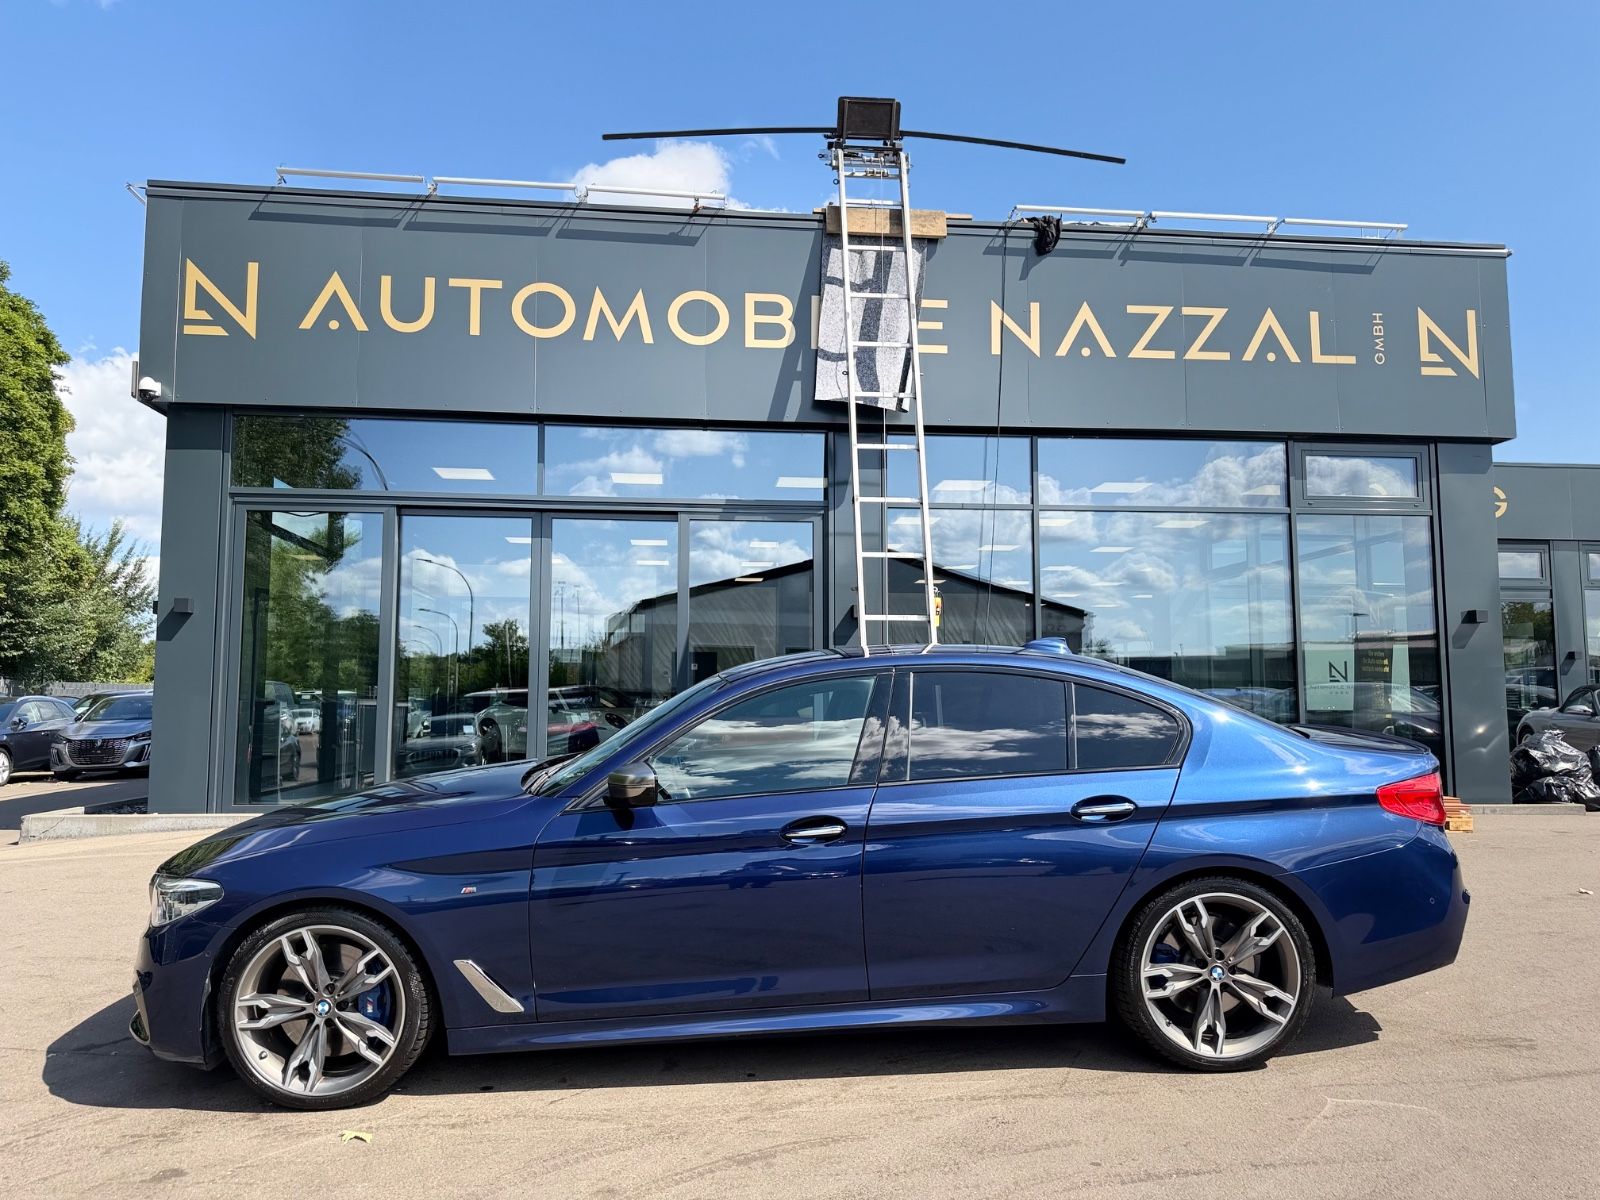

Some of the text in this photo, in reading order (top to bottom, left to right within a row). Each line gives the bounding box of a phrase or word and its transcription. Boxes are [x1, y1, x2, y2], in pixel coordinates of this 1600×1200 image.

[299, 270, 1356, 365] AUTOMOBIE NAZZAL
[1372, 313, 1385, 365] GMBH
